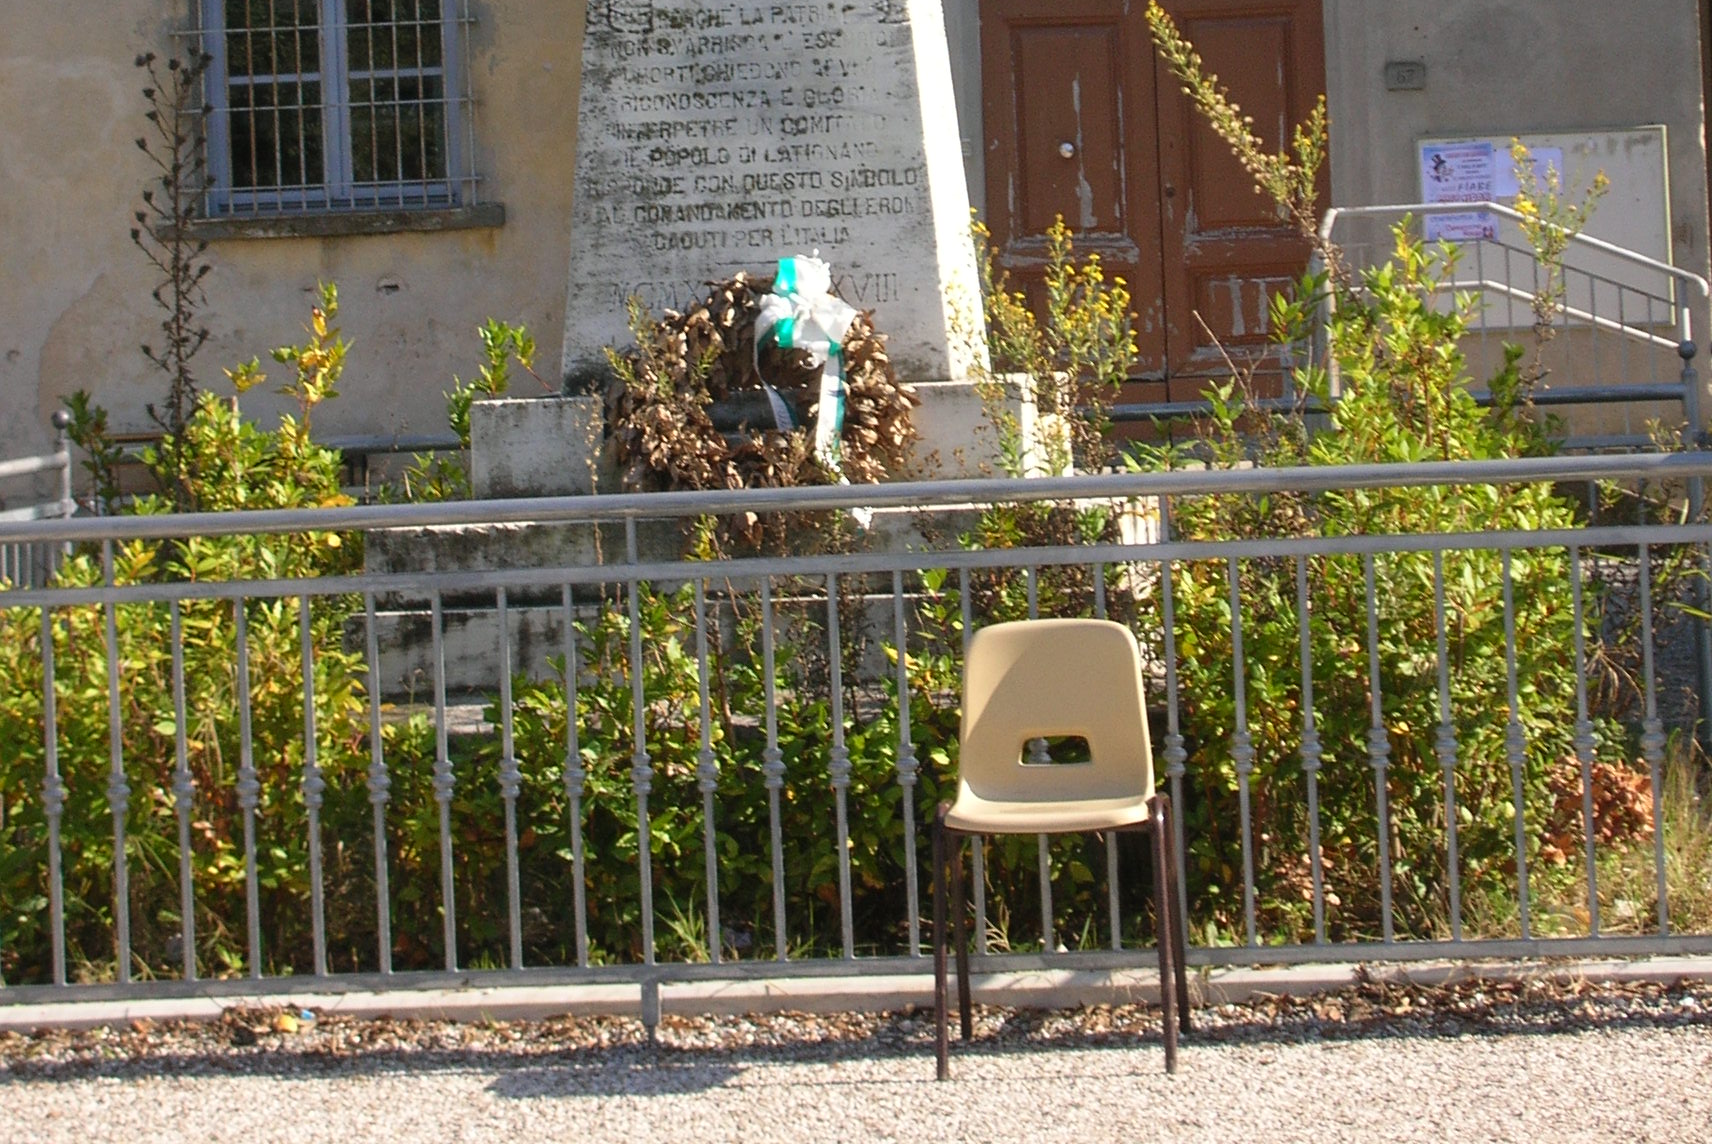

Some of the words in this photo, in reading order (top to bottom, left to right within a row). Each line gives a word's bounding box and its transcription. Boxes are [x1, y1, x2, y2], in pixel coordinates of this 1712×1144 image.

[741, 7, 763, 25] LA
[771, 5, 838, 24] PATRIA
[611, 35, 649, 58] NON
[702, 60, 801, 82] CHIEDONO
[620, 89, 771, 112] RICONOSCENZA
[781, 87, 794, 106] E
[747, 116, 773, 136] UN
[781, 113, 886, 136] COMITO
[649, 146, 731, 169] POPOLO
[738, 144, 756, 164] DI
[585, 175, 686, 199] RSPONDE
[694, 174, 735, 194] CON
[742, 170, 823, 197] QUESTO
[830, 167, 918, 192] SIMBOLO
[633, 200, 793, 225] COMANDAMENTO
[653, 229, 728, 251] CADUTI
[733, 229, 774, 248] PER
[781, 224, 851, 247] L'ITALIA
